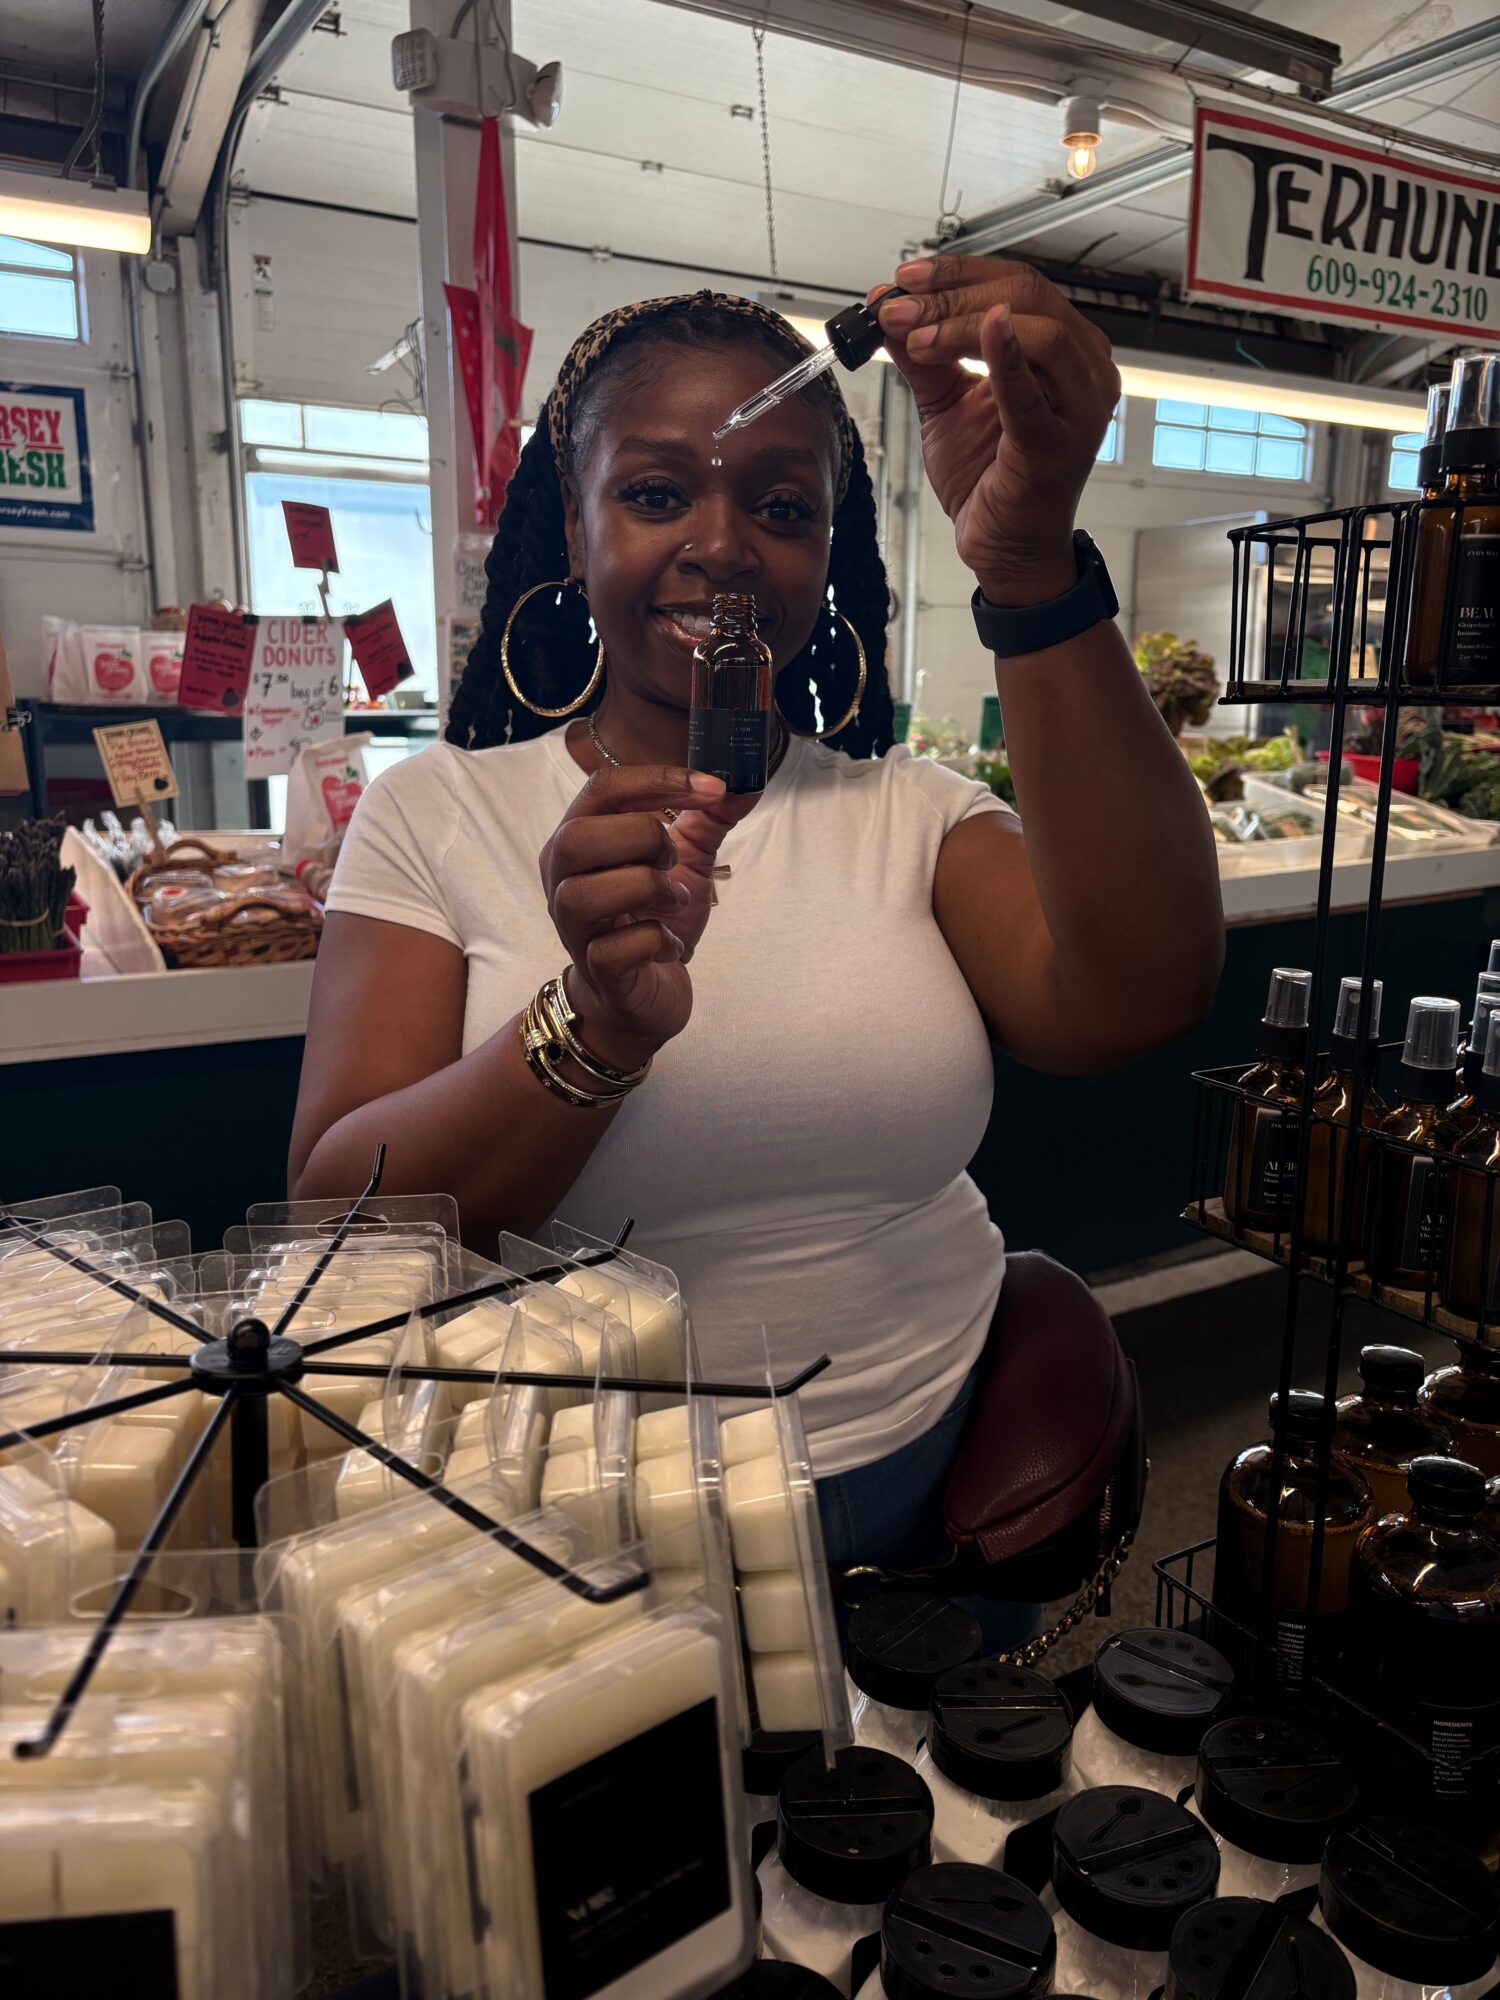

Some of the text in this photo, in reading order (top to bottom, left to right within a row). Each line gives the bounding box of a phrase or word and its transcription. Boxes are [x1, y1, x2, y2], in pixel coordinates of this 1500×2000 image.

[1307, 254, 1487, 321] 609-924-2310
[267, 619, 329, 646] CIDER
[262, 645, 337, 669] DONUTS
[327, 673, 339, 697] 6
